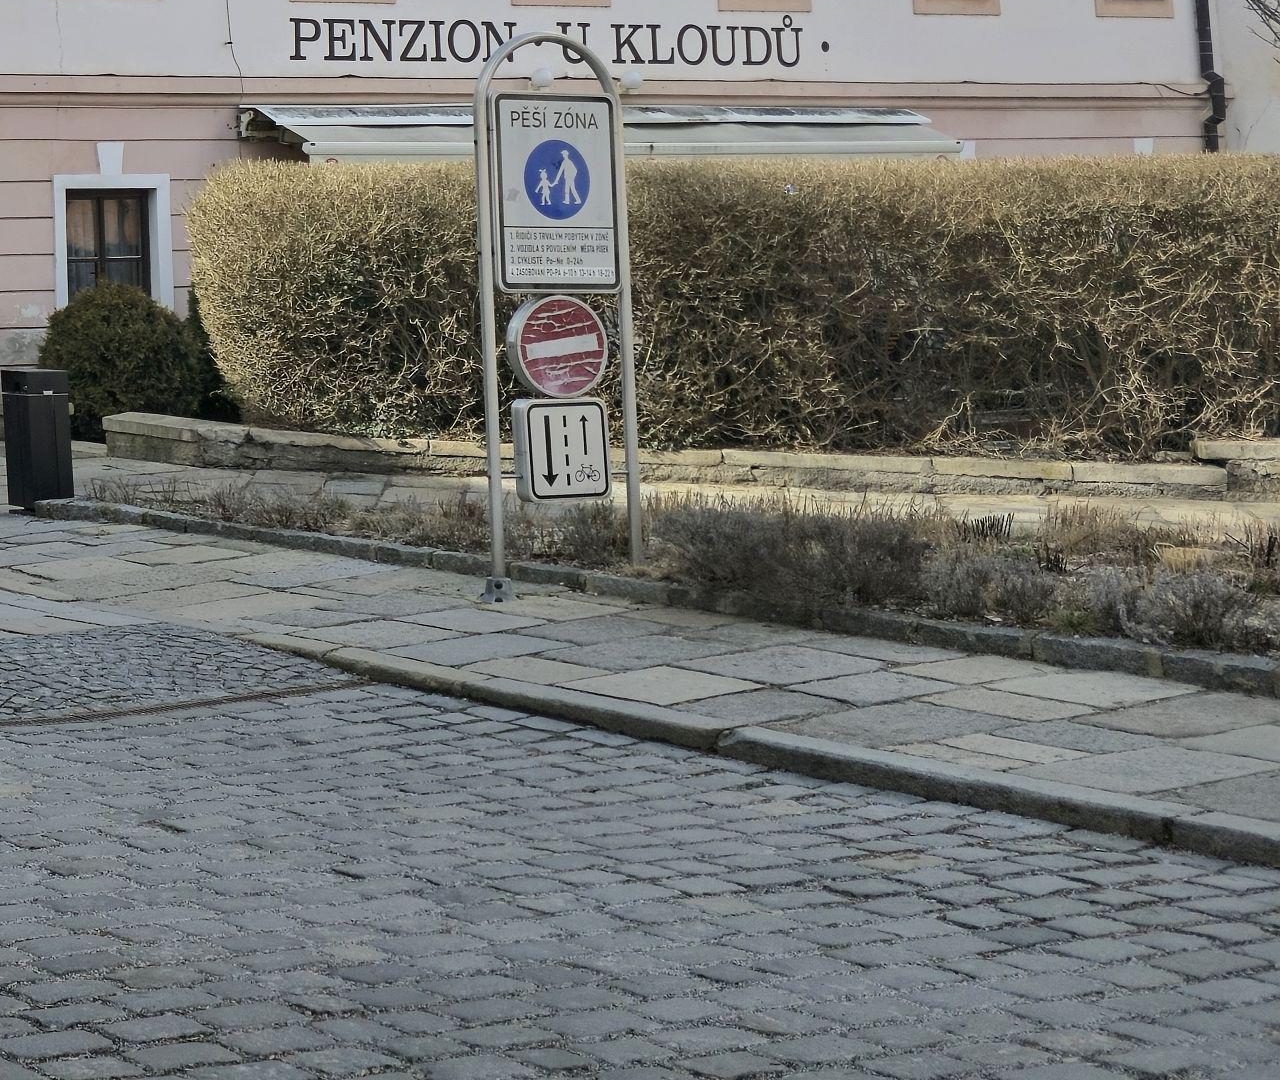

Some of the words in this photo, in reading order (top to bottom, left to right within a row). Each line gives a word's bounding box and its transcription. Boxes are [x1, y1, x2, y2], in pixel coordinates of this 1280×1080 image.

[289, 17, 517, 63] PENZION
[556, 21, 590, 65] U
[610, 15, 803, 67] KLOUDŮ
[510, 106, 547, 128] PĚŠÍ
[553, 107, 598, 129] ZÓNA
